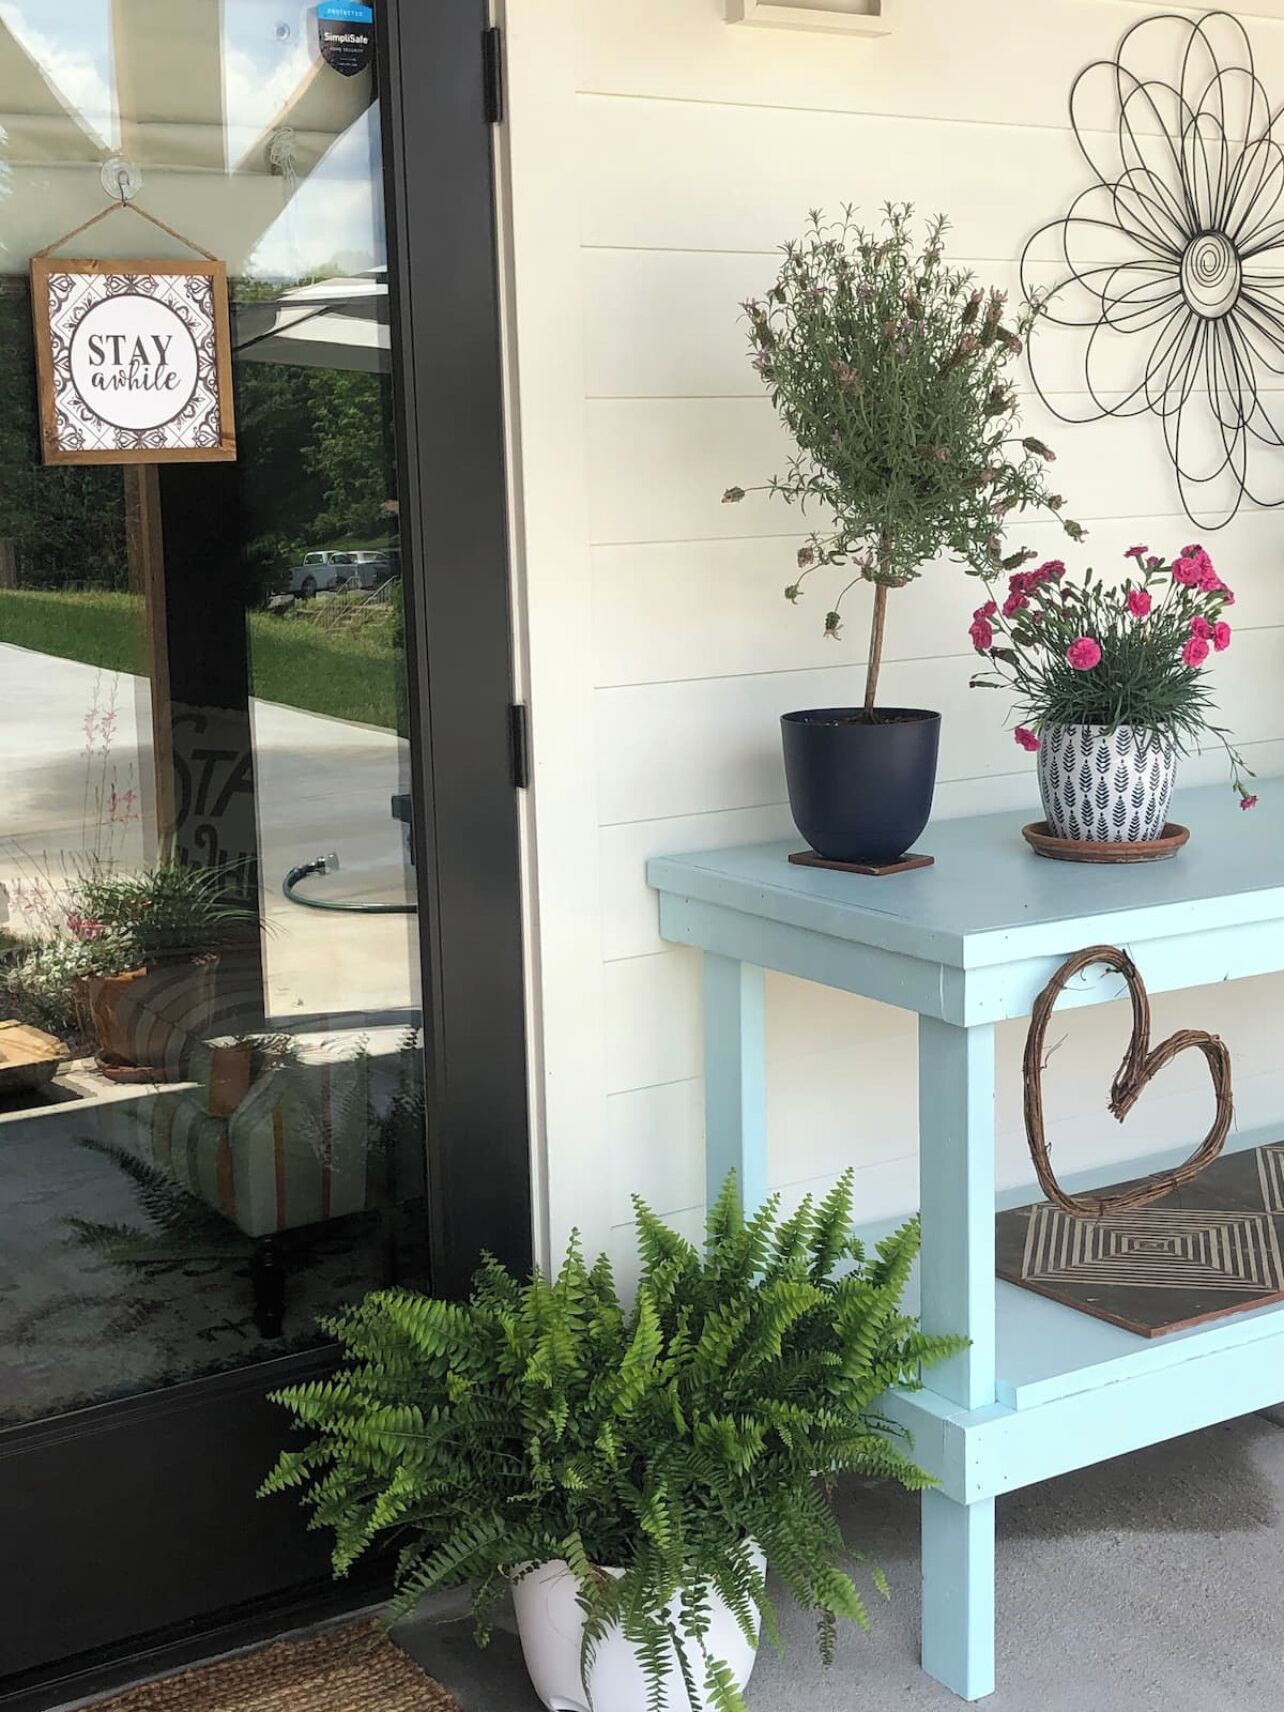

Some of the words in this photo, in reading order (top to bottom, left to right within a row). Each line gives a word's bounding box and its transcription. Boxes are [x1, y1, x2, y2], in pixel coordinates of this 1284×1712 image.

[324, 32, 369, 45] SimpliSafe
[88, 334, 173, 367] STAY
[91, 358, 182, 391] awhile
